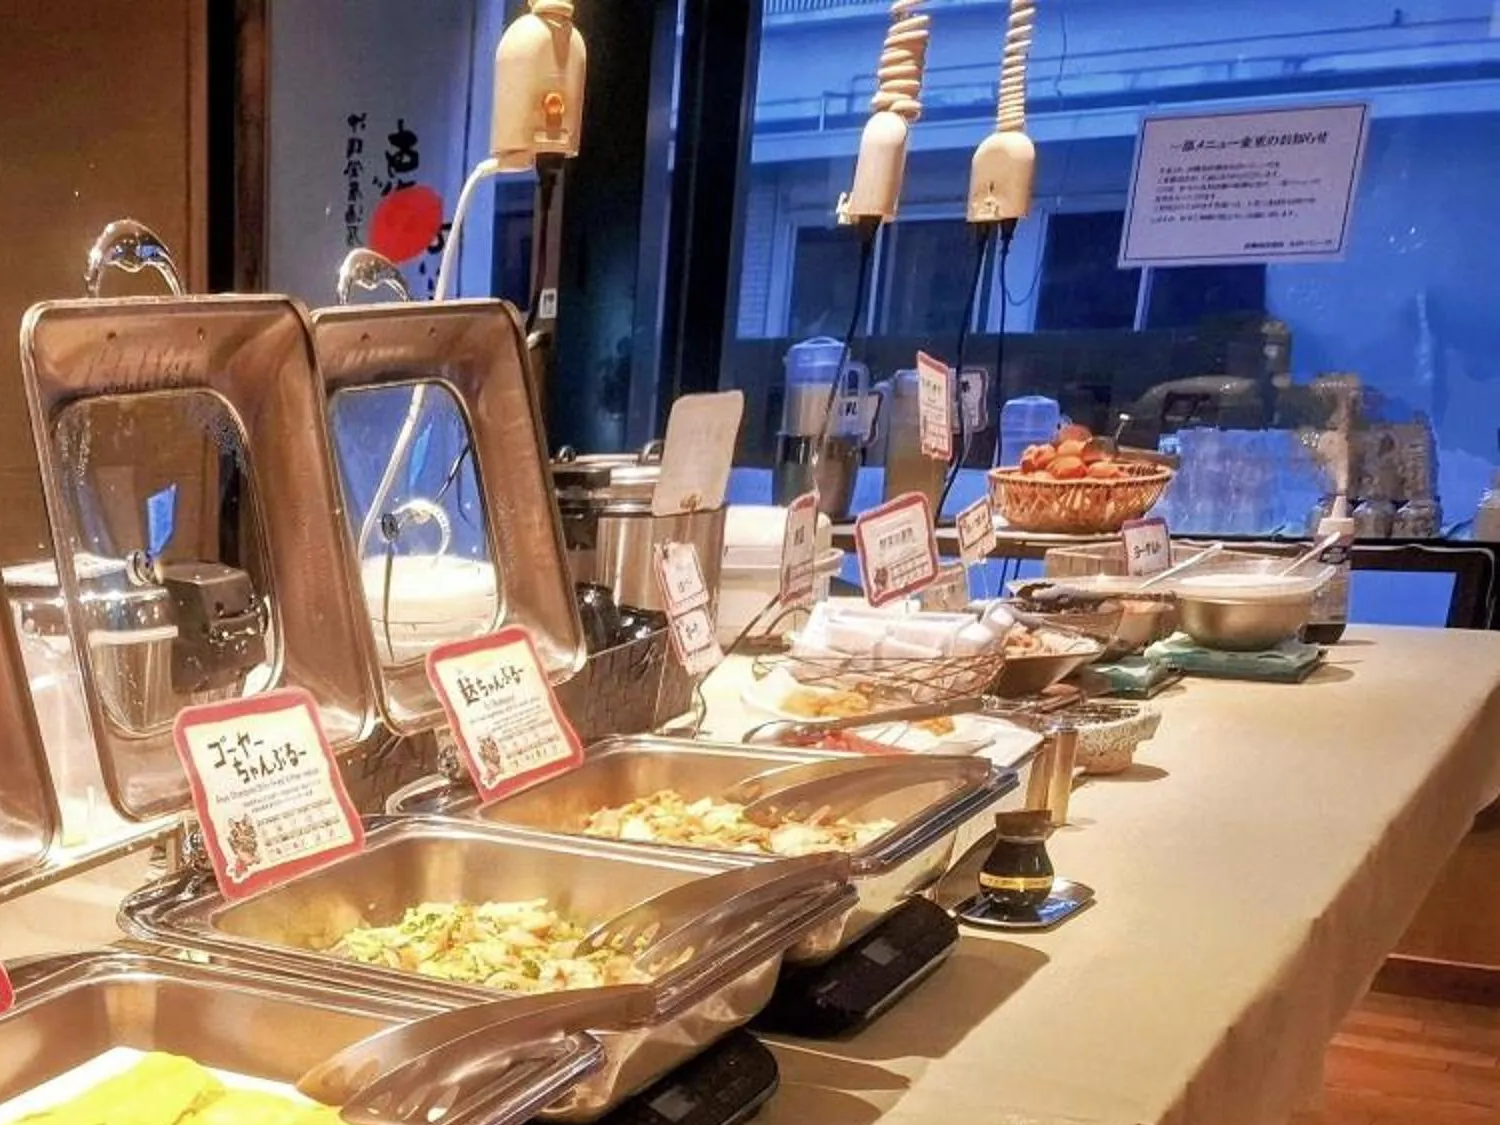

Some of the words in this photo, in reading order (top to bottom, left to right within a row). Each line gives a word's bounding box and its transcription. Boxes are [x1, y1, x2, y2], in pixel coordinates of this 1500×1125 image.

[207, 730, 265, 768] ゴーヤー
[232, 742, 307, 784] ちゃんぷるー
